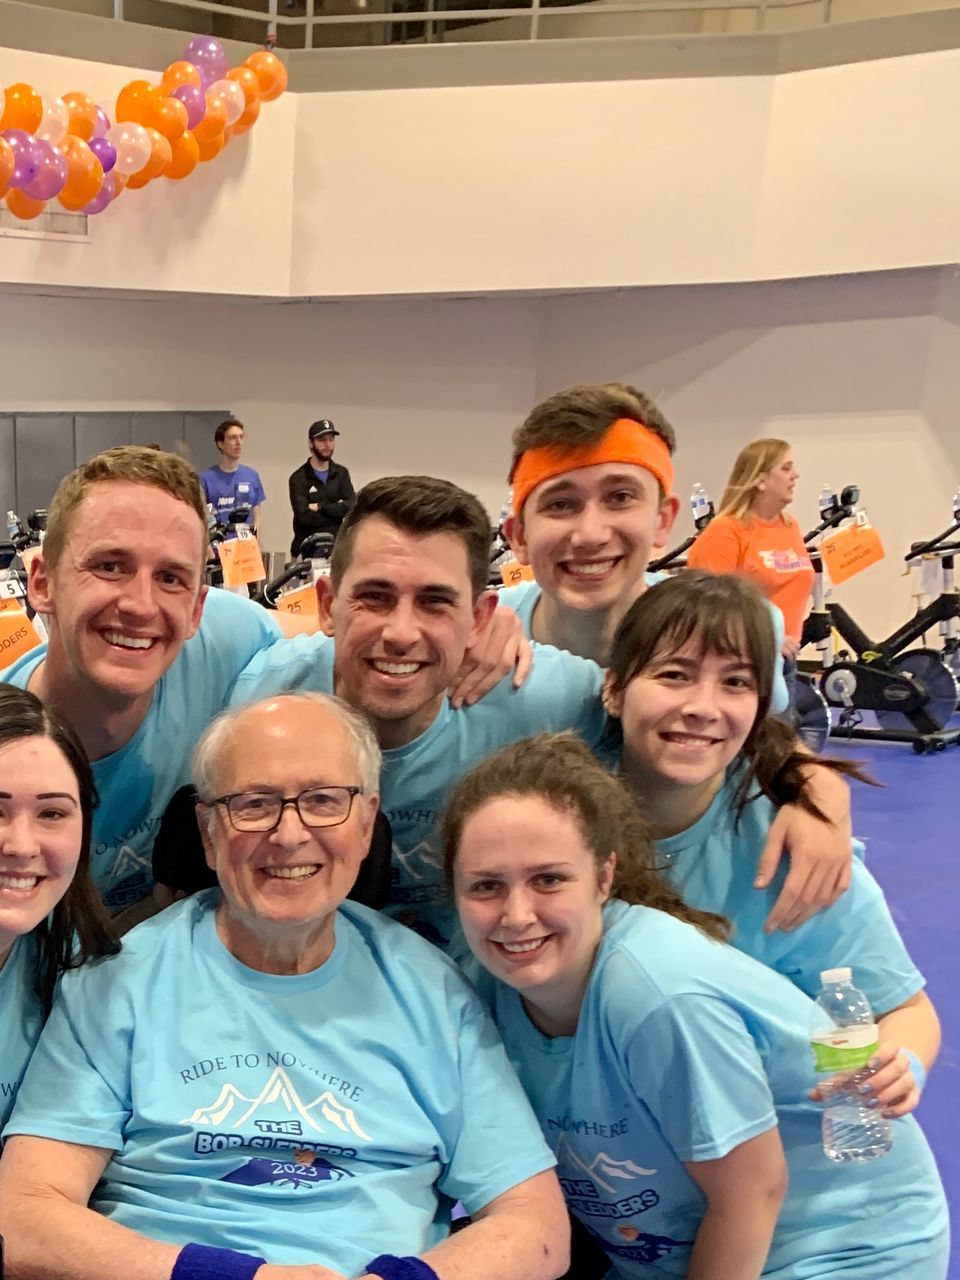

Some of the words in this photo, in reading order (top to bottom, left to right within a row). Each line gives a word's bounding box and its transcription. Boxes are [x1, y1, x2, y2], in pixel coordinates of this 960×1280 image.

[509, 567, 524, 581] 25
[6, 583, 16, 595] 5
[287, 600, 303, 614] 25
[180, 1055, 227, 1084] RIDE
[230, 1053, 260, 1069] TO
[254, 1119, 303, 1136] THE
[270, 1161, 318, 1177] 2023
